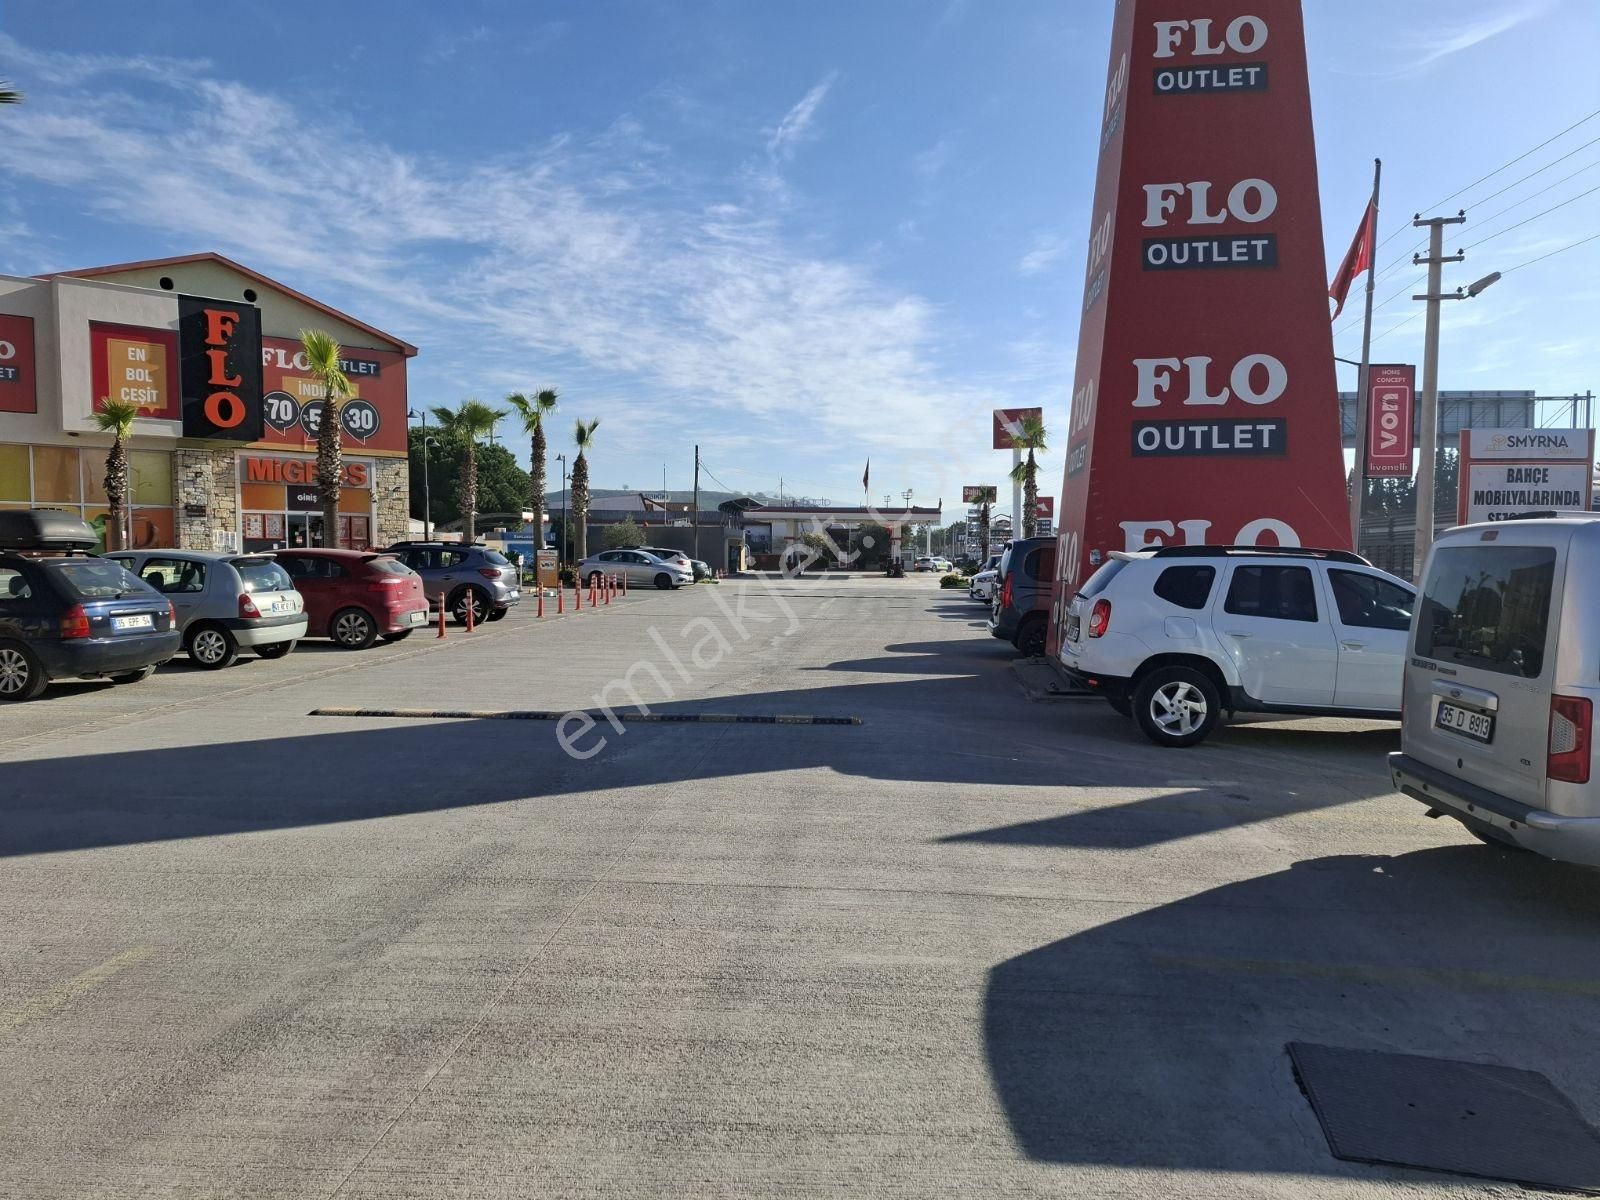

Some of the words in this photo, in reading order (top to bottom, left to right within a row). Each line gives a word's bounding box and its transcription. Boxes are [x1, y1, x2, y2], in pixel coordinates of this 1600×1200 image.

[1153, 15, 1268, 58] FLO
[1156, 67, 1261, 91] OUTLET
[1141, 178, 1278, 227] FLO
[1147, 239, 1269, 265] OUTLET
[127, 347, 147, 362] EN
[125, 367, 153, 383] BOL
[203, 308, 246, 429] FLO
[1131, 353, 1288, 407] FLO
[120, 386, 159, 406] ÇEŞİT
[1137, 424, 1276, 451] OUTLET
[1506, 435, 1569, 448] SMYRNA
[1506, 467, 1549, 486] BAHÇE
[1442, 706, 1454, 723] 35
[1456, 710, 1465, 727] D
[1468, 714, 1490, 736] 8913
